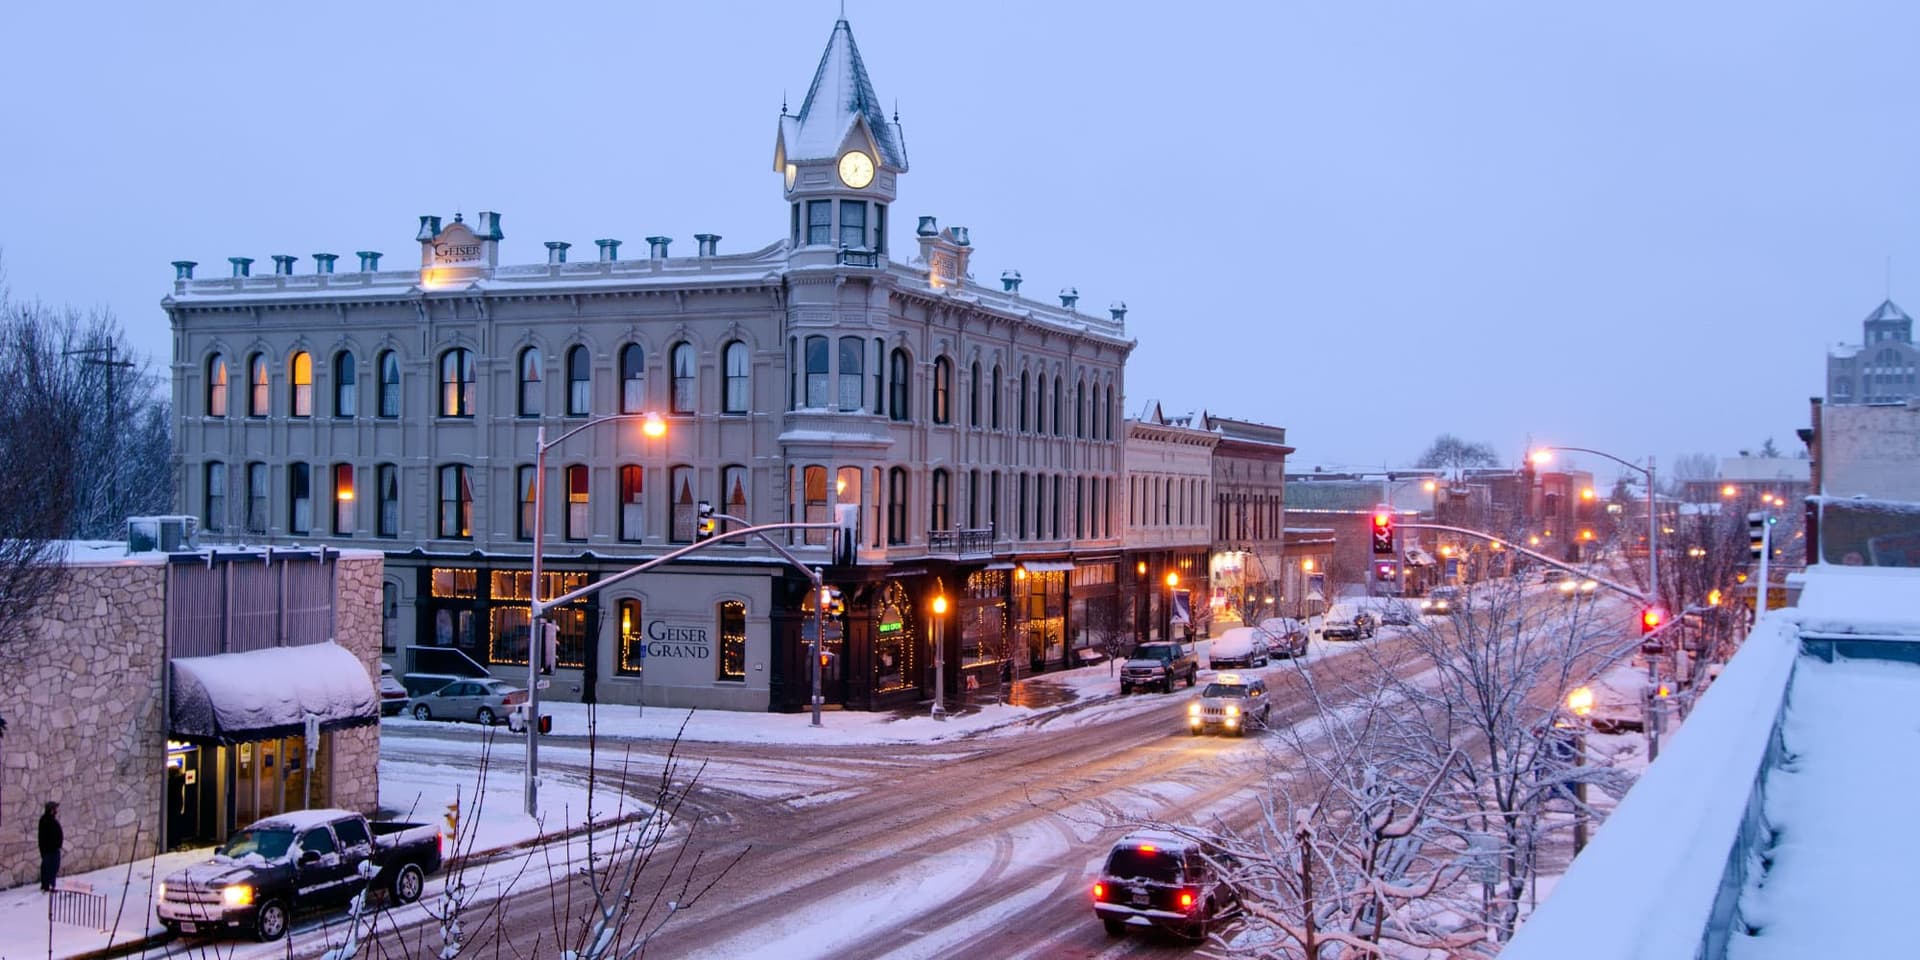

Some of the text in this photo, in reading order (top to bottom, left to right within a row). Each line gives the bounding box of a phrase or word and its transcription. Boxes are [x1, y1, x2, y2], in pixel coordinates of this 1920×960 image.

[434, 243, 481, 257] GEISER
[647, 620, 708, 642] GEISER
[647, 641, 710, 659] GRAND
